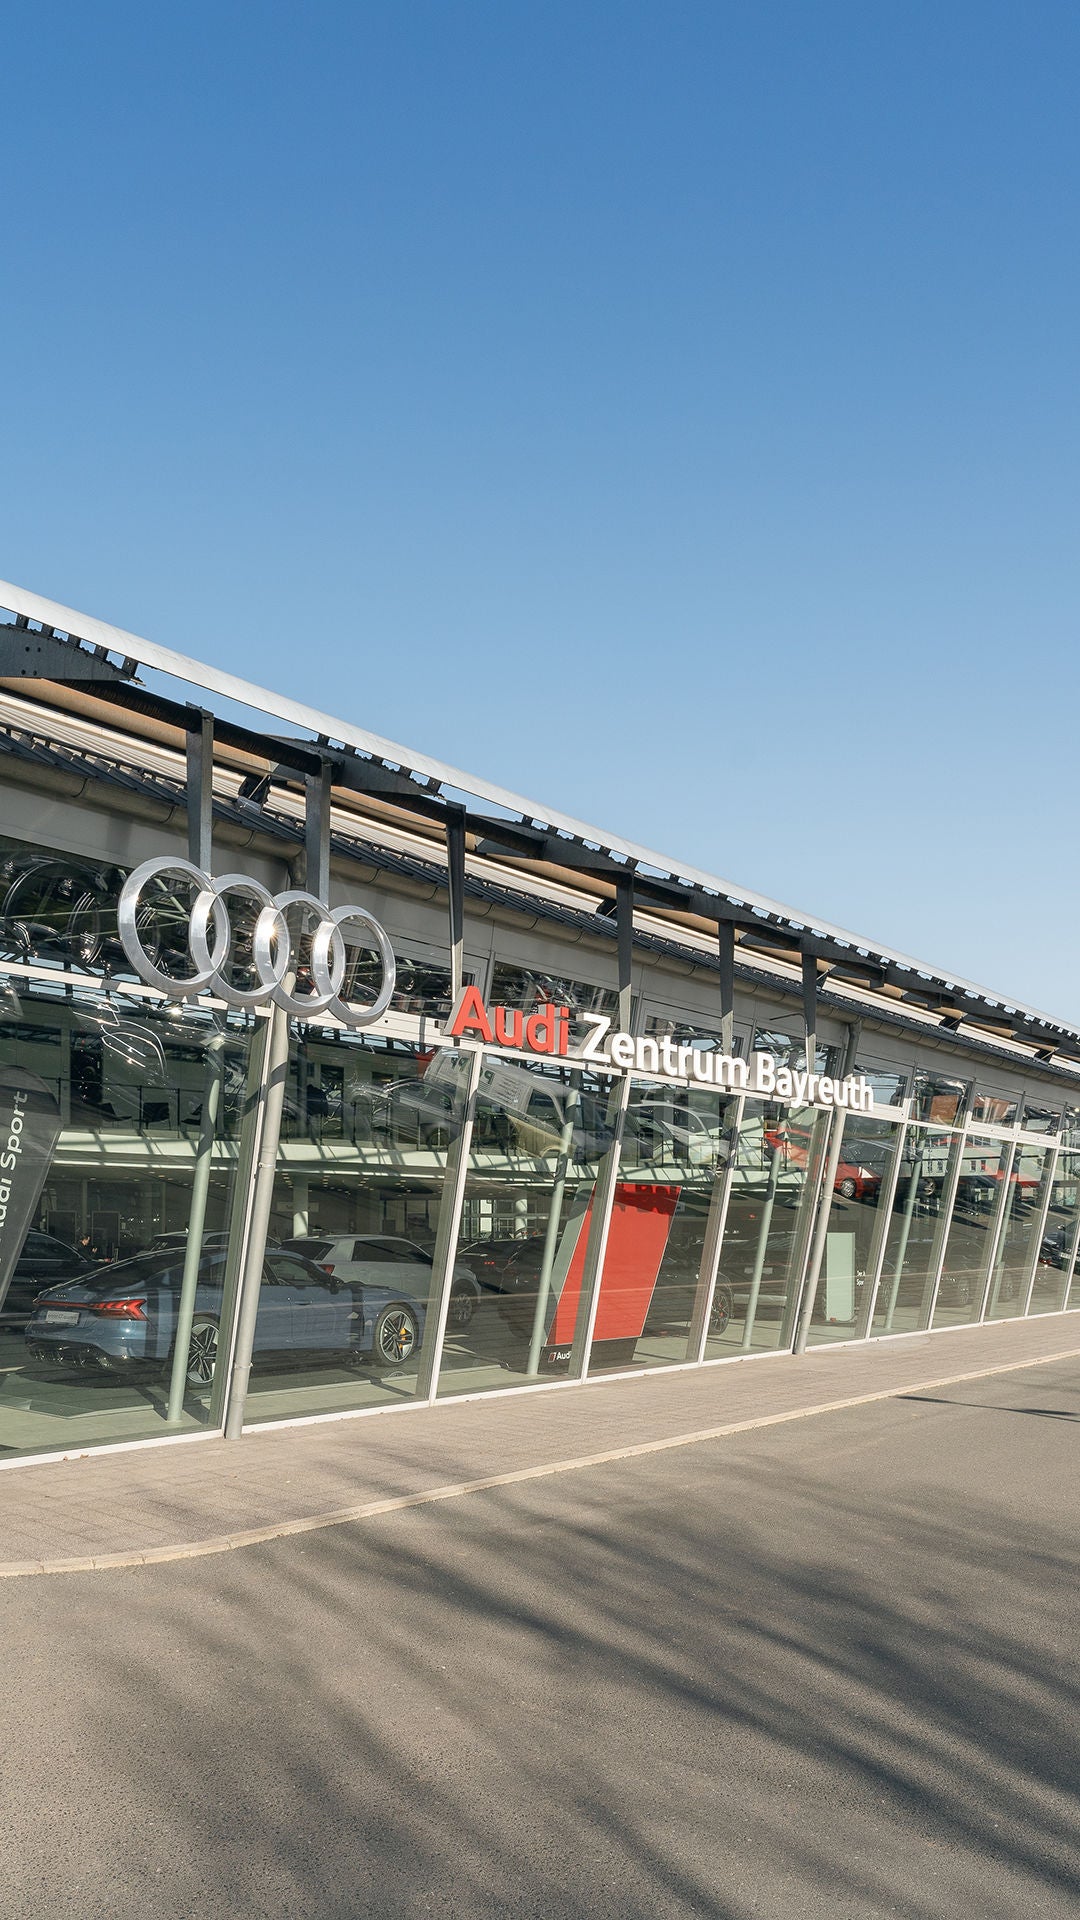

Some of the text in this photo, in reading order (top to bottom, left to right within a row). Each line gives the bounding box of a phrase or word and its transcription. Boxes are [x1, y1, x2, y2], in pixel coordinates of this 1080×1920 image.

[450, 985, 874, 1112] Audi Zentrum Bayreuth
[1, 1090, 28, 1171] Sport
[556, 1351, 572, 1360] Aud
